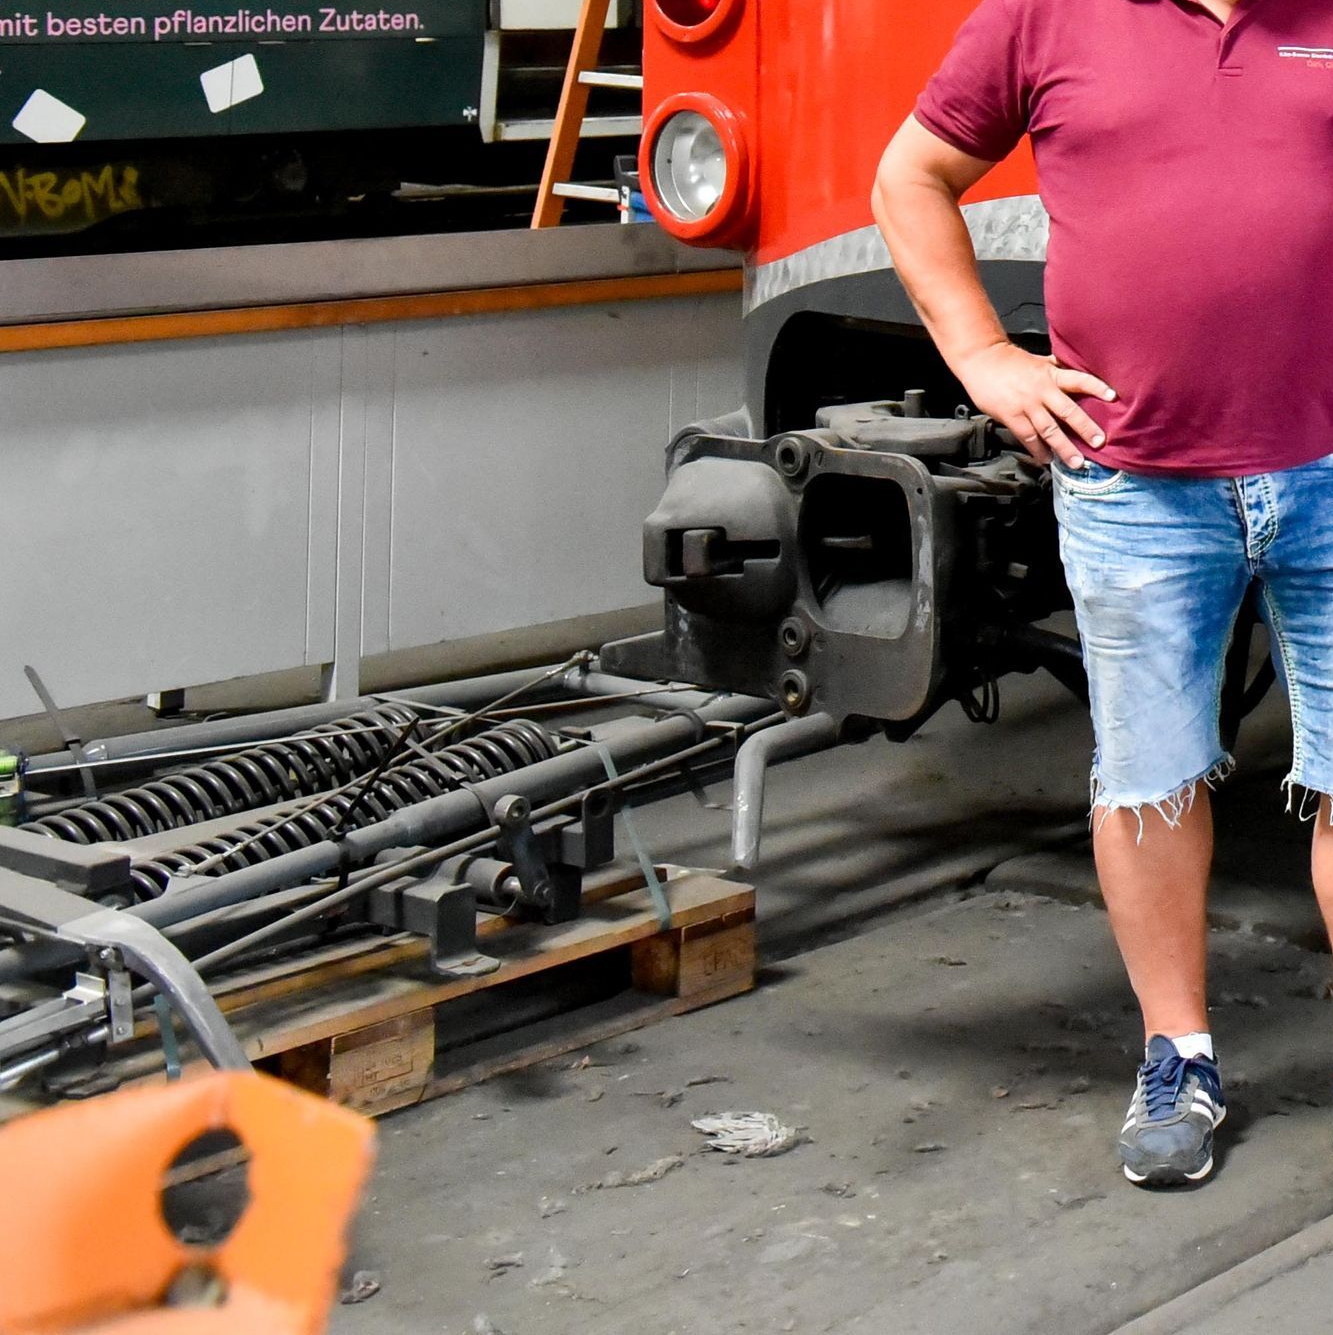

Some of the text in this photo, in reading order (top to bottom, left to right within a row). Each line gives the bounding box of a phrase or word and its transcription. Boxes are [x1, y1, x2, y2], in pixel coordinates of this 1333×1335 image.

[46, 11, 146, 37] besten
[154, 9, 312, 42] pflanzlichen
[318, 8, 425, 32] Zutaten.
